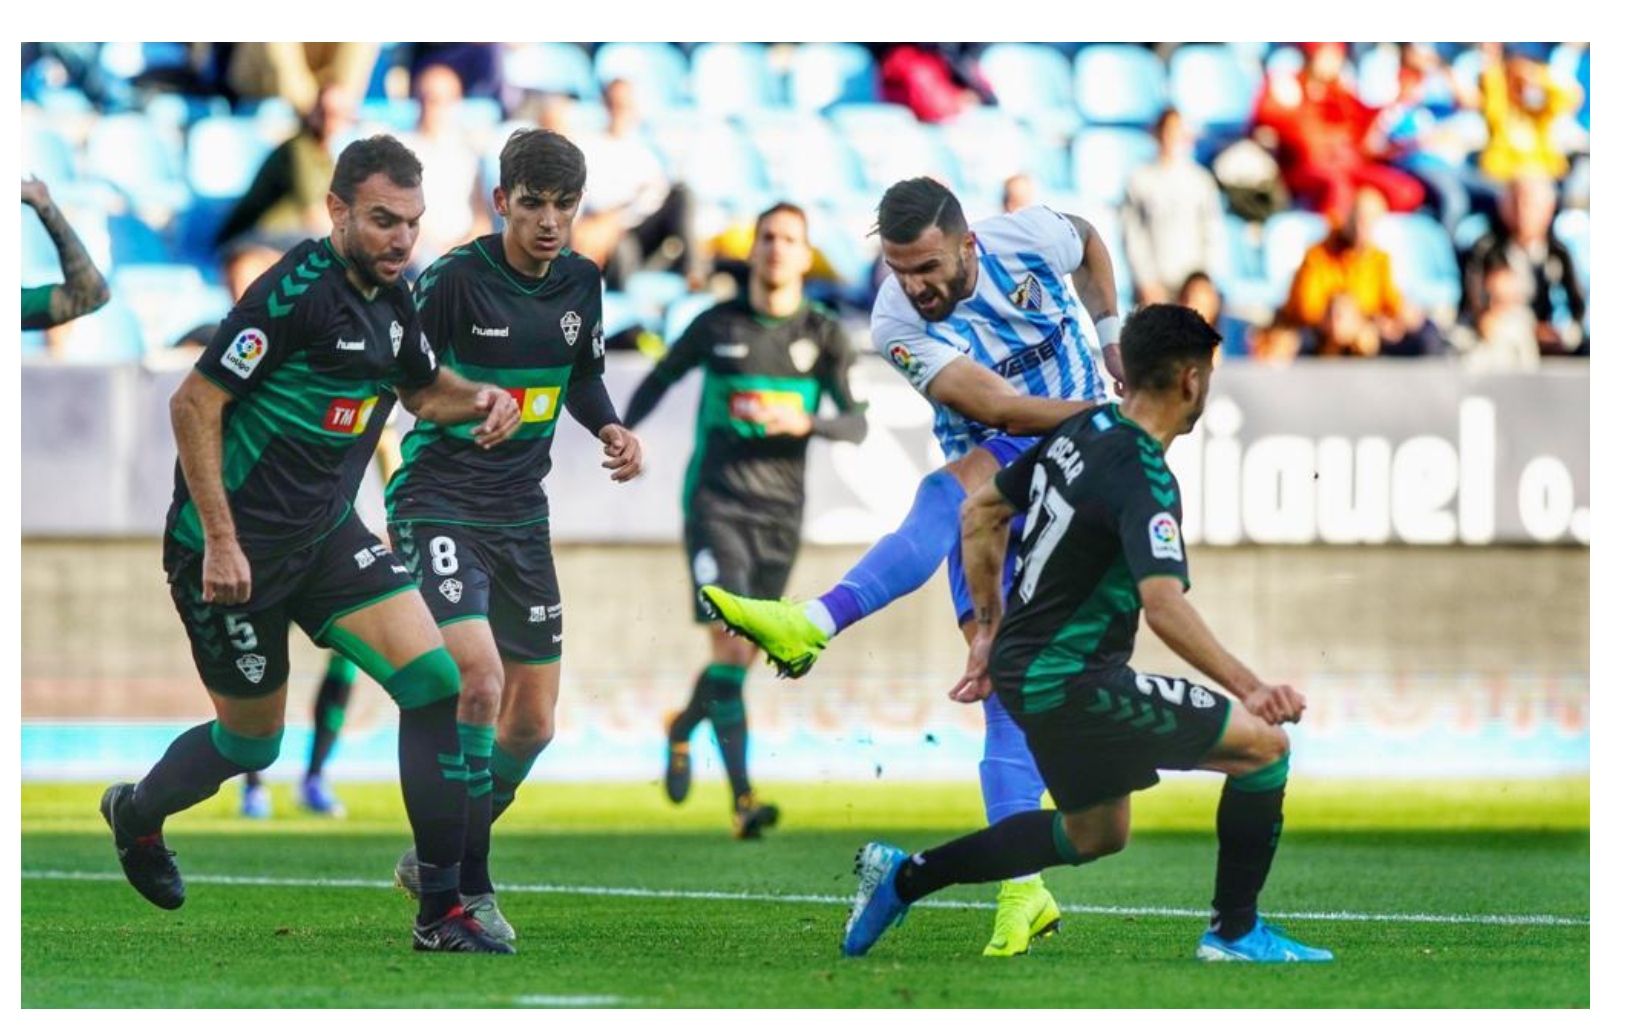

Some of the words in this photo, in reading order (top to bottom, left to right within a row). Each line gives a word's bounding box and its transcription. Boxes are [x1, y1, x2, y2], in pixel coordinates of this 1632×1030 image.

[330, 406, 356, 426] TM
[429, 535, 459, 576] 8
[225, 613, 258, 651] 5
